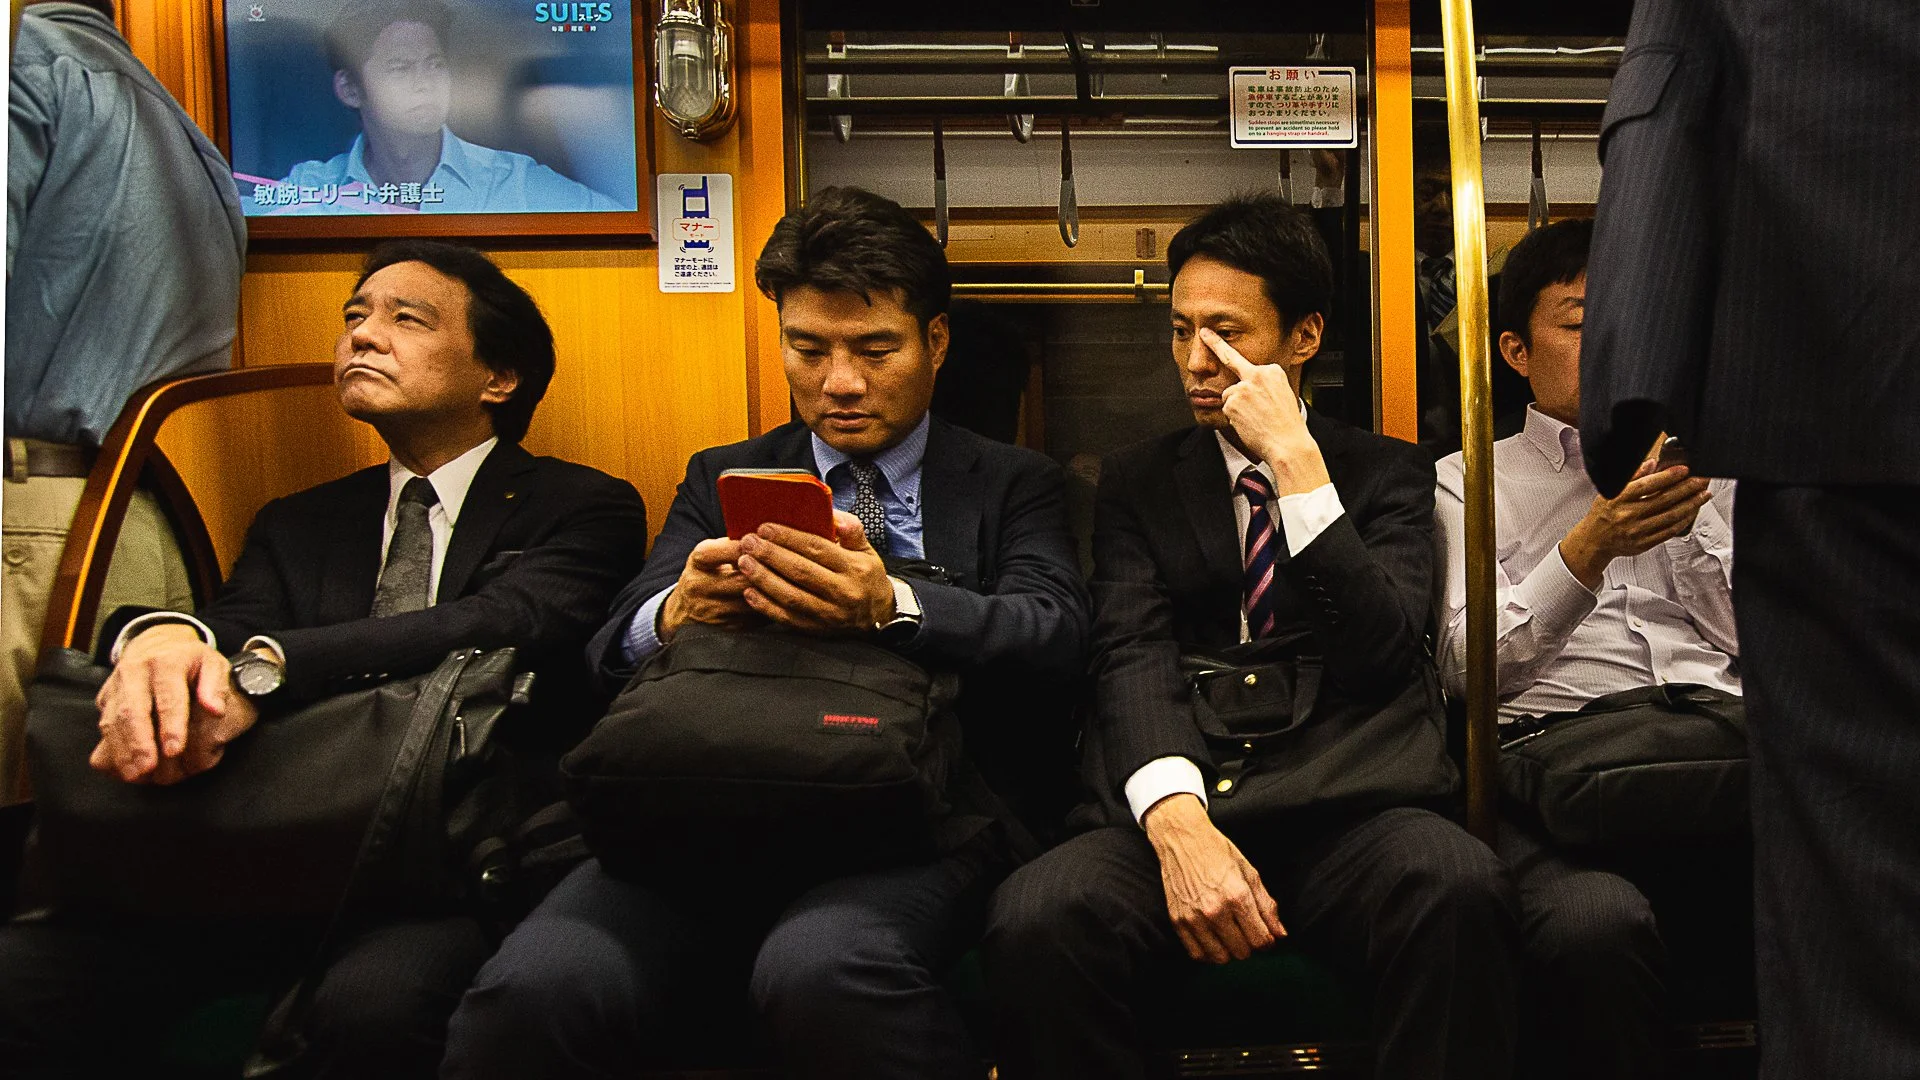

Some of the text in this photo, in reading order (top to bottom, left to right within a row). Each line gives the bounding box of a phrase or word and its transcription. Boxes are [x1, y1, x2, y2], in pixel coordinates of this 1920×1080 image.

[535, 2, 612, 22] SUITS
[1269, 69, 1316, 81] お願い
[1247, 85, 1340, 93] 電車は事故防止のため
[1247, 93, 1339, 101] 急停車することがありま
[1248, 101, 1340, 109] すので、つり革や手すりに
[1248, 109, 1331, 117] おつかまりください。
[253, 182, 445, 206] 敏腕エリート弁護士
[679, 222, 714, 231] マナー
